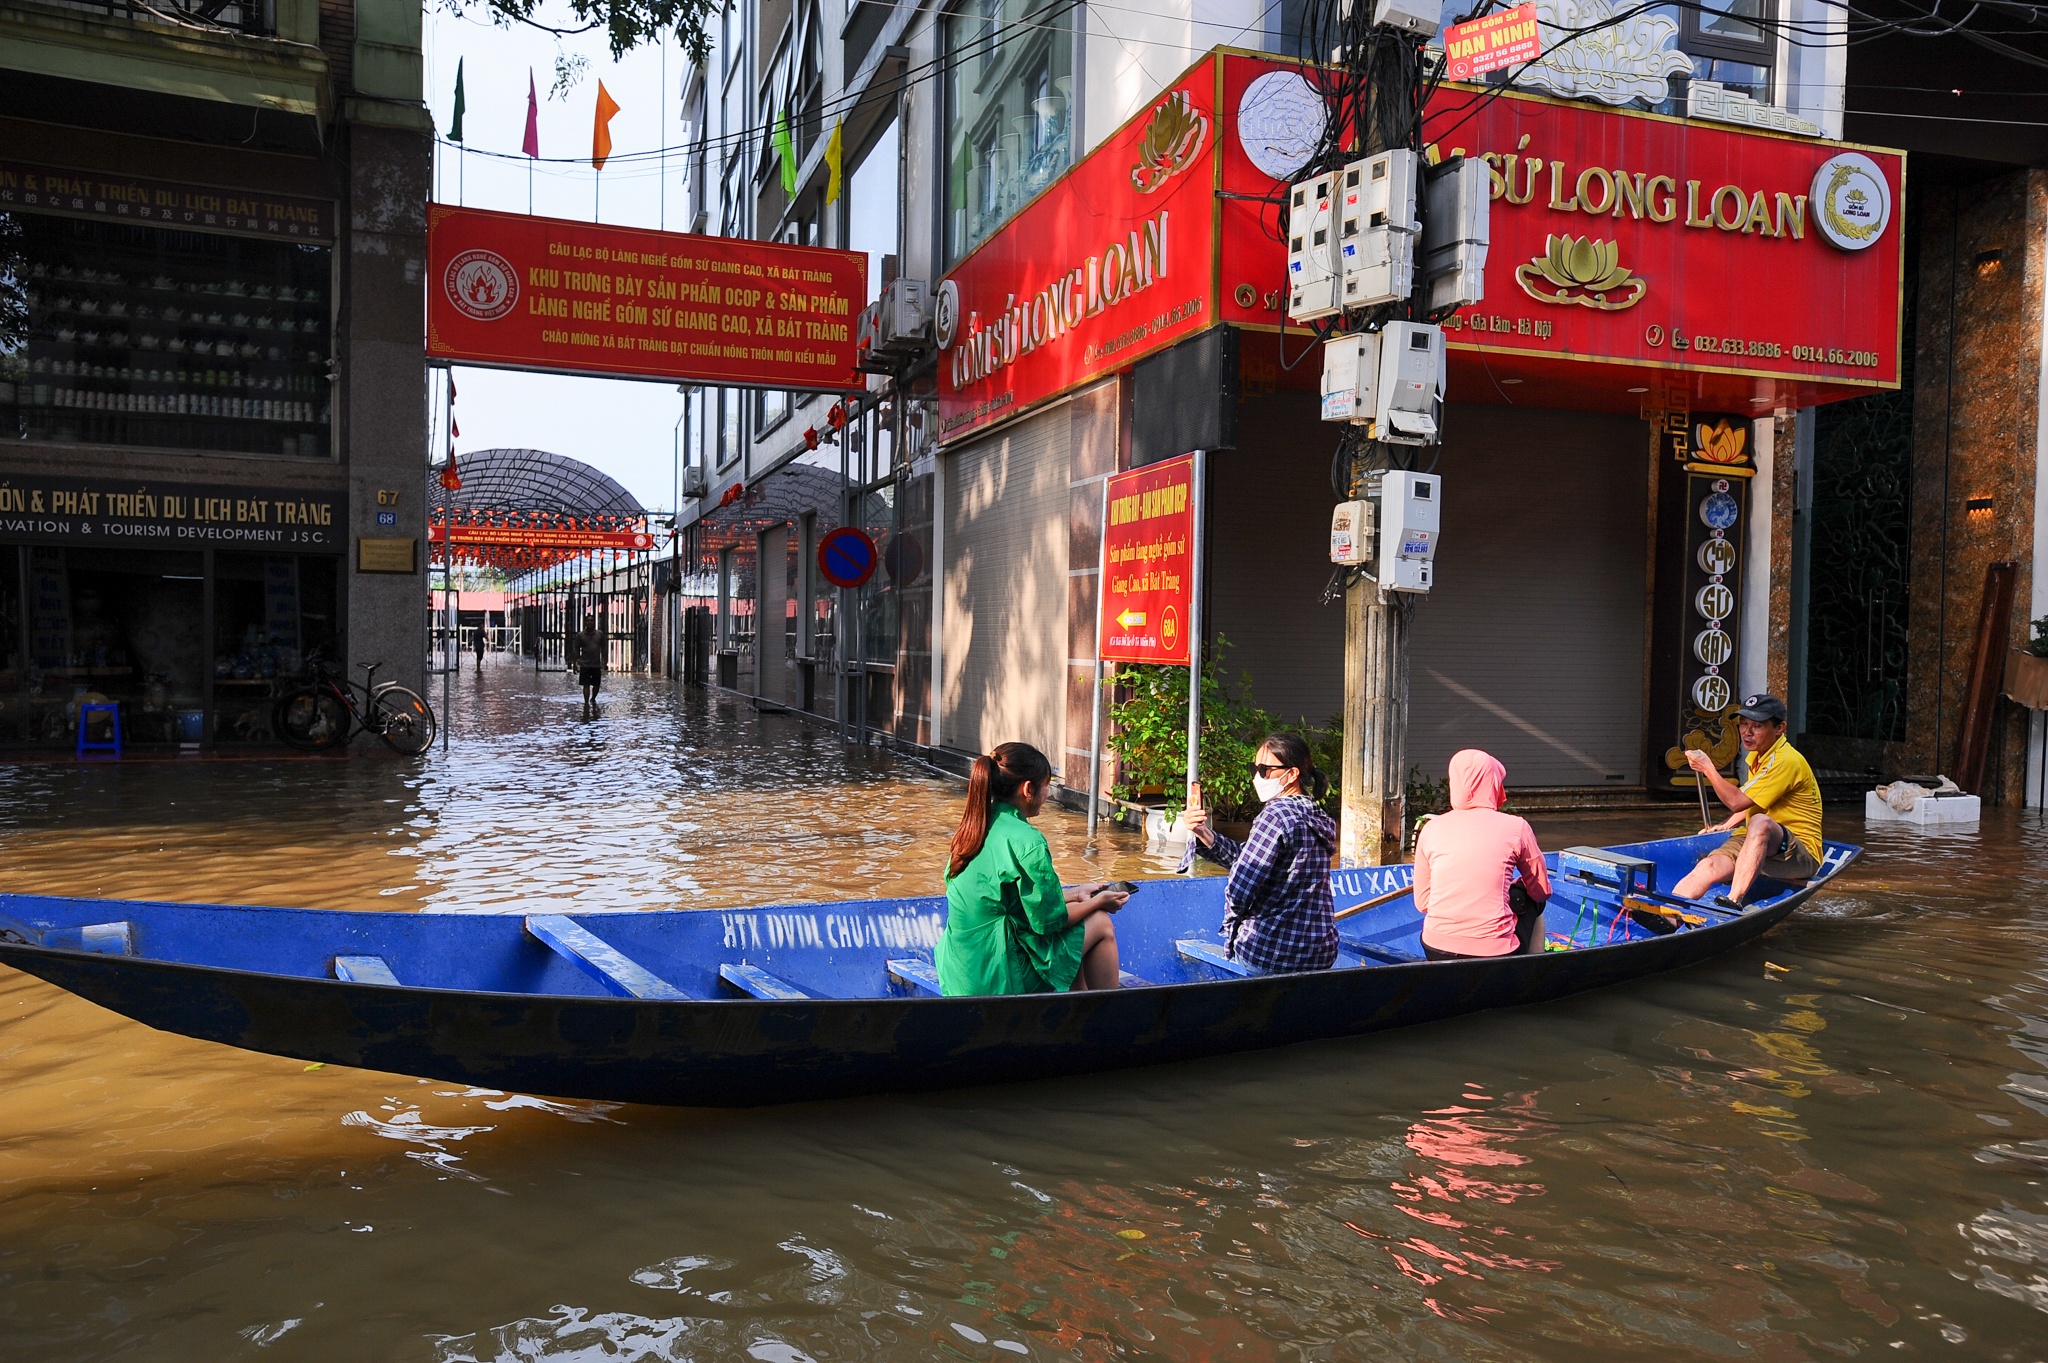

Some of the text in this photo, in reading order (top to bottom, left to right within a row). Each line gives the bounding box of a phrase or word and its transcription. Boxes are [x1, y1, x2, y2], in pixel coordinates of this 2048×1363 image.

[1449, 20, 1536, 60] VẠN NINH
[1460, 22, 1479, 36] BÁN
[1473, 52, 1494, 64] 0327
[1496, 48, 1508, 58] 56
[24, 173, 40, 191] &
[45, 176, 94, 198] PHÁT
[155, 189, 179, 208] DU
[185, 193, 221, 214] LỊCH
[226, 198, 258, 217] BÁT
[1481, 133, 1543, 204] SỨ
[1547, 160, 1677, 224] LONG
[1685, 179, 1808, 240] LOAN
[549, 242, 571, 257] CÂU
[573, 246, 594, 261] LẠC
[595, 247, 610, 263] BỘ
[612, 249, 638, 264] LÀNG
[670, 254, 693, 269] GỐM
[695, 258, 710, 271] SỨ
[711, 261, 741, 274] GIANG
[743, 263, 765, 278] CAO,
[766, 265, 780, 279] XÃ
[782, 267, 801, 280] BÁT
[802, 269, 833, 283] TRÀNG
[529, 267, 849, 316] KHU TRƯNG BÀY SẢN PHẨM OCOP & SẢN PHẨM
[992, 294, 1020, 370] SỨ
[1020, 269, 1083, 356] LONG
[1085, 211, 1168, 319] LOAN
[529, 293, 848, 342] LÀNG NGHỀ GỐM SỨ GIANG CAO, XÃ BÁT TRÀNG
[1471, 313, 1487, 331] Gia
[1490, 315, 1510, 333] Lâm
[1518, 318, 1531, 336] Hà
[1535, 319, 1551, 341] Nội
[542, 329, 837, 366] CHÀO MỪNG XÃ BÁT TRÀNG ĐẠT CHUẨN NÔNG THÔN MỚI KIỂU MẪU
[1694, 336, 1781, 358] 032.633.8686
[1792, 344, 1879, 368] 0914.66.2006
[31, 490, 45, 513] &
[52, 487, 100, 515] PHÁT
[106, 486, 157, 518] TRIỂN
[164, 496, 187, 519] DU
[194, 497, 231, 524] LỊCH
[237, 496, 269, 523] BÁT
[275, 498, 331, 526] TRÀNG
[377, 489, 400, 507] 67
[81, 522, 92, 534] &
[103, 523, 171, 537] TOURISM
[178, 526, 283, 541] DEVELOPMENT
[379, 512, 395, 525] 68
[1112, 574, 1128, 598] Giang
[1150, 571, 1160, 591] Bát
[1161, 569, 1180, 595] Tràng
[1164, 618, 1175, 637] 68A
[1700, 630, 1731, 665] BÁT
[721, 914, 762, 950] HTX
